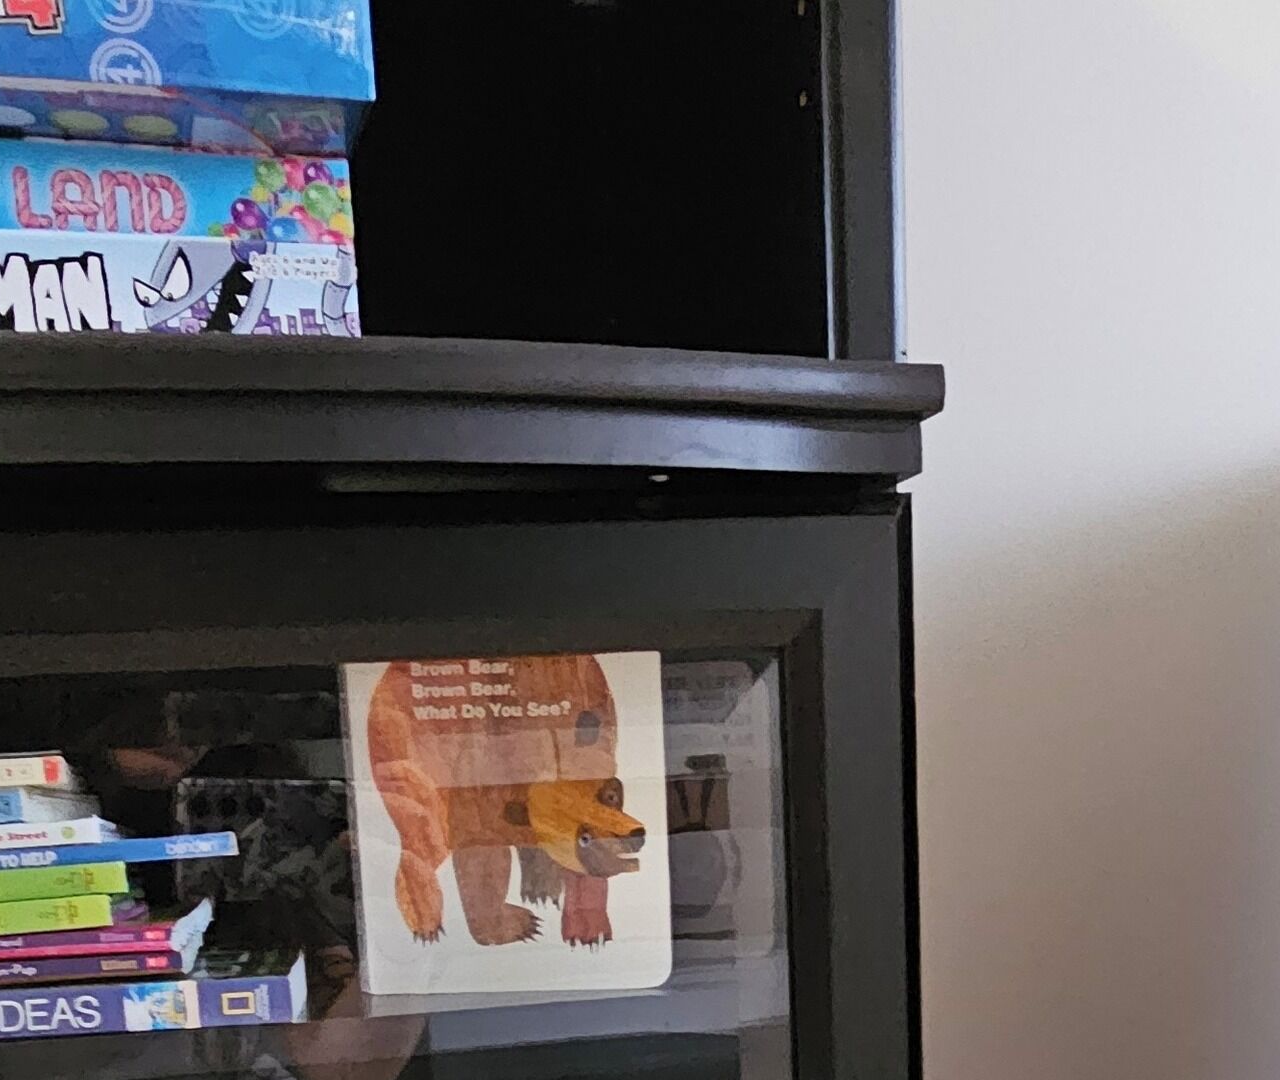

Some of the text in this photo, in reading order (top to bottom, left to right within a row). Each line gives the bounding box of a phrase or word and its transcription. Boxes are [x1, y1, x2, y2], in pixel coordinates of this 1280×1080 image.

[13, 165, 188, 235] LAND
[410, 661, 465, 677] Brown
[411, 683, 467, 698] Brown
[413, 700, 571, 720] What Do You See?
[7, 831, 49, 842] Street
